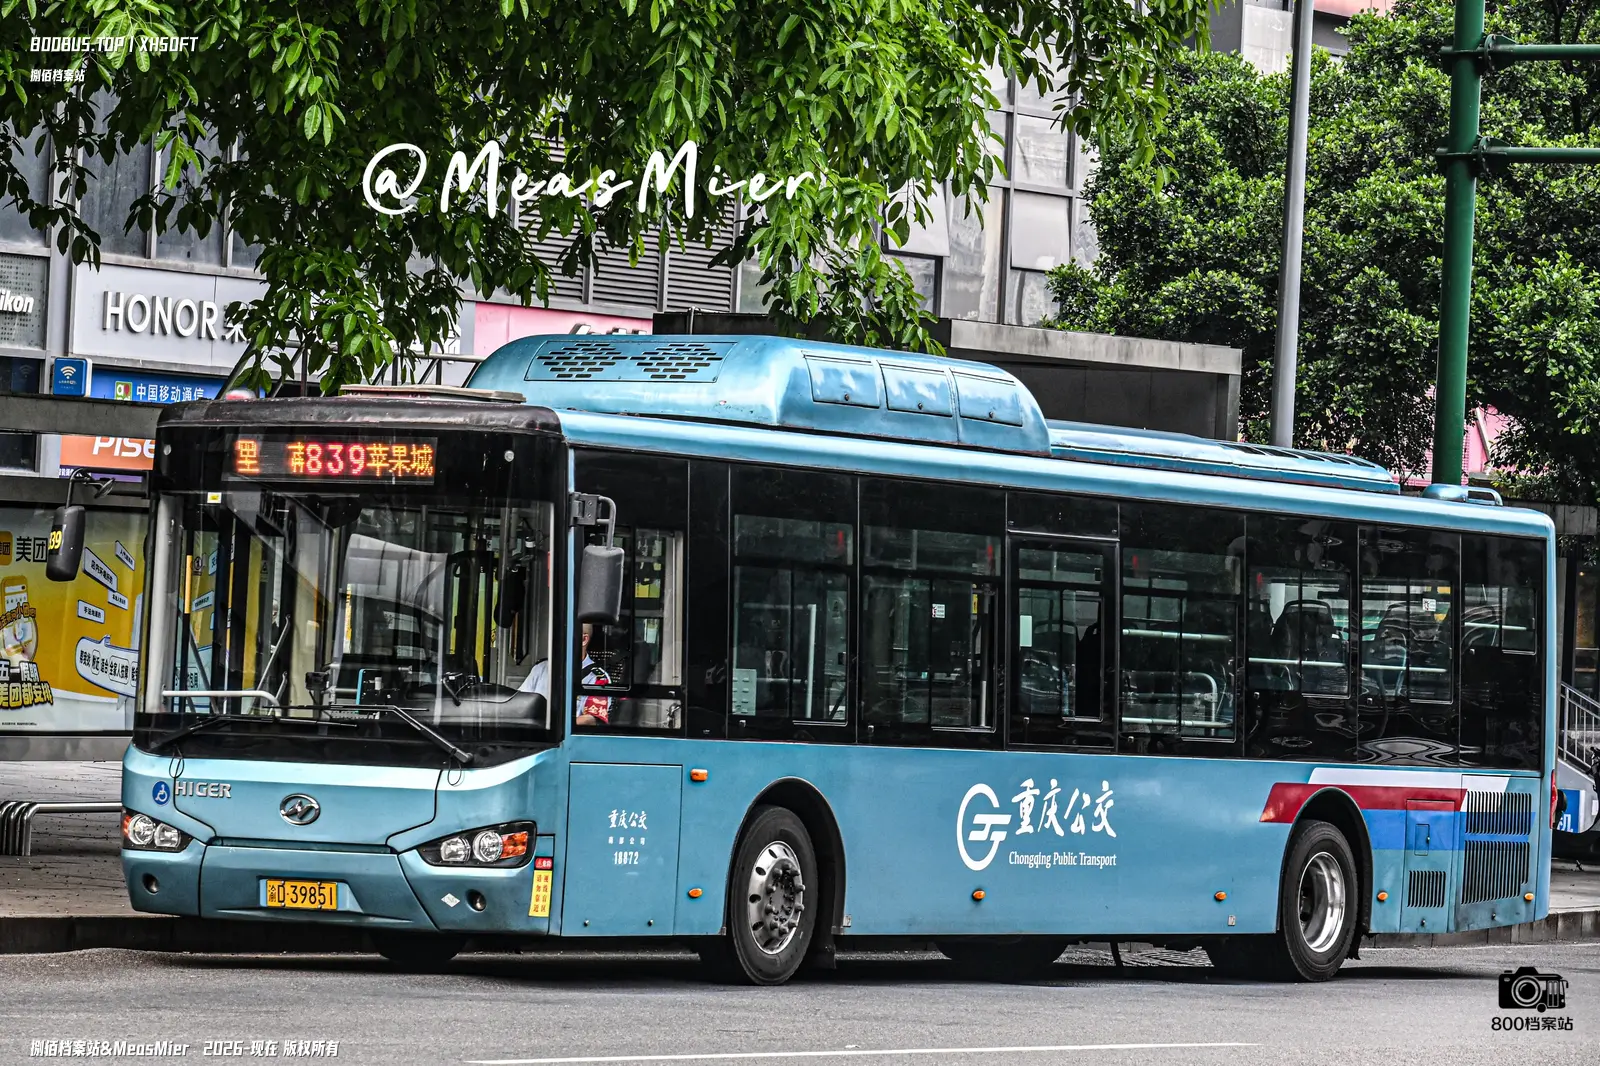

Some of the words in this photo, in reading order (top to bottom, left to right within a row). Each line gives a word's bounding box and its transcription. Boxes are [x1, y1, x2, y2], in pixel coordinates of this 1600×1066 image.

[0, 289, 34, 313] ikon
[102, 291, 218, 340] HONOR
[136, 384, 204, 401] 中国移动通信
[15, 536, 48, 562] 美团
[0, 682, 53, 708] 美团都安排
[174, 781, 232, 799] HIGER
[1012, 778, 1117, 838] 重庆公交
[608, 809, 648, 830] 重庆公交
[614, 851, 639, 865] 18872
[1008, 851, 1051, 868] Chongqing
[1053, 851, 1078, 866] Public
[1079, 852, 1117, 869] Transport
